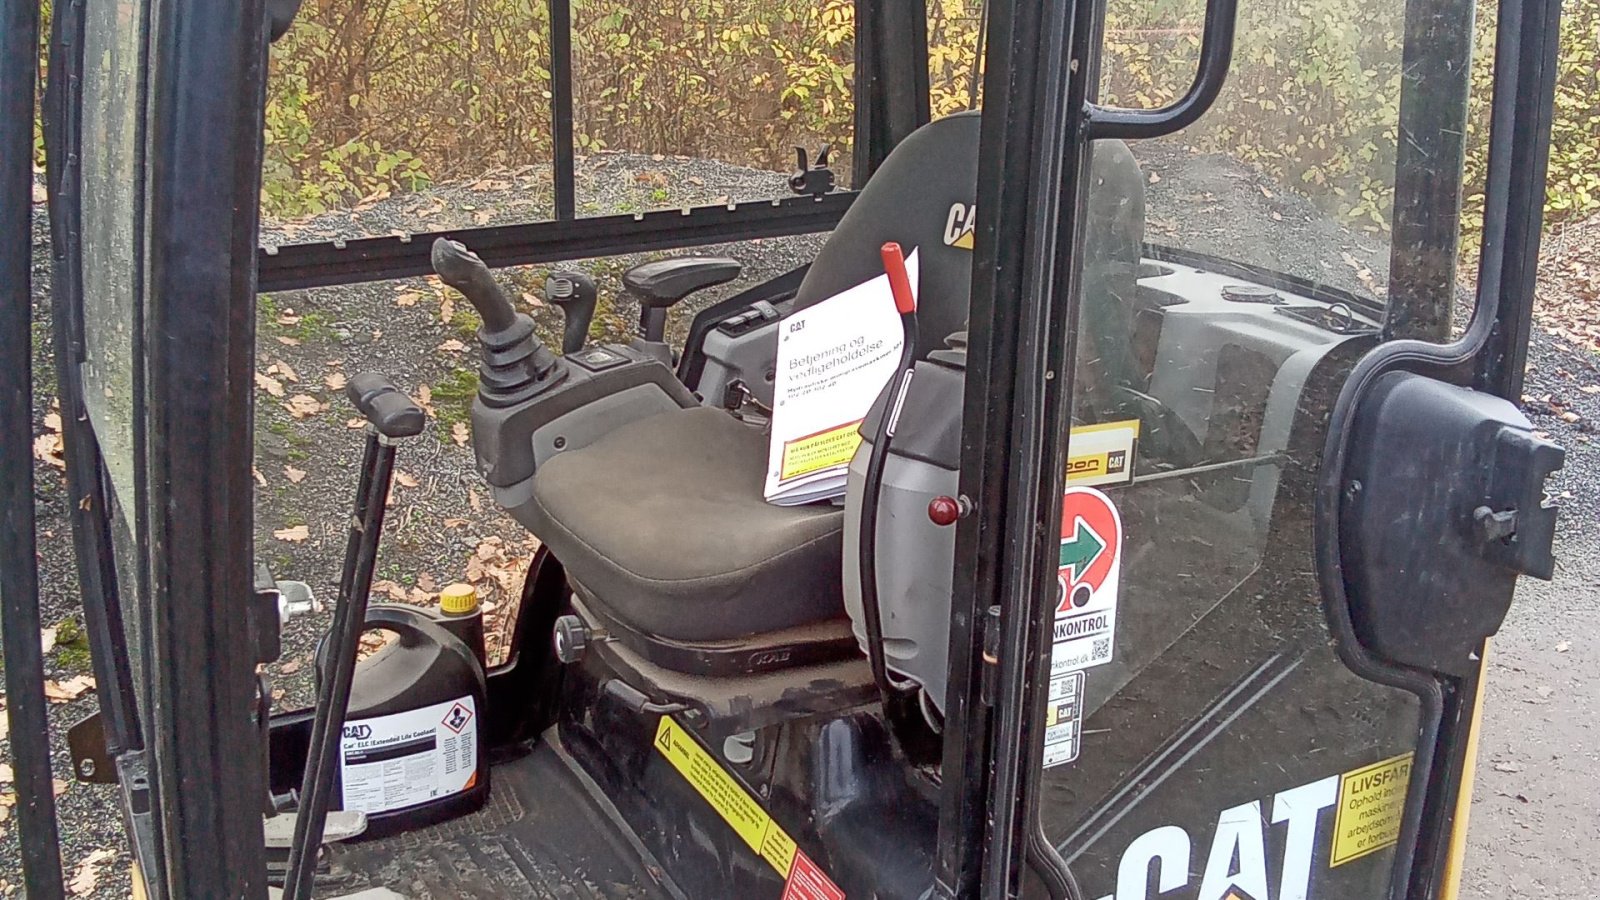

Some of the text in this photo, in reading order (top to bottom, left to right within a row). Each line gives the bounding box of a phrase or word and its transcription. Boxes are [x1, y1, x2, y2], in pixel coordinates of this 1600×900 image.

[790, 320, 805, 333] CAT
[789, 336, 865, 370] Betjening og
[1108, 455, 1124, 468] CAT
[1053, 614, 1109, 639] NKONTROL
[1058, 706, 1073, 719] CAT
[343, 724, 371, 740] CAT
[1349, 789, 1383, 810] Ophold
[1115, 773, 1339, 900] CAT
